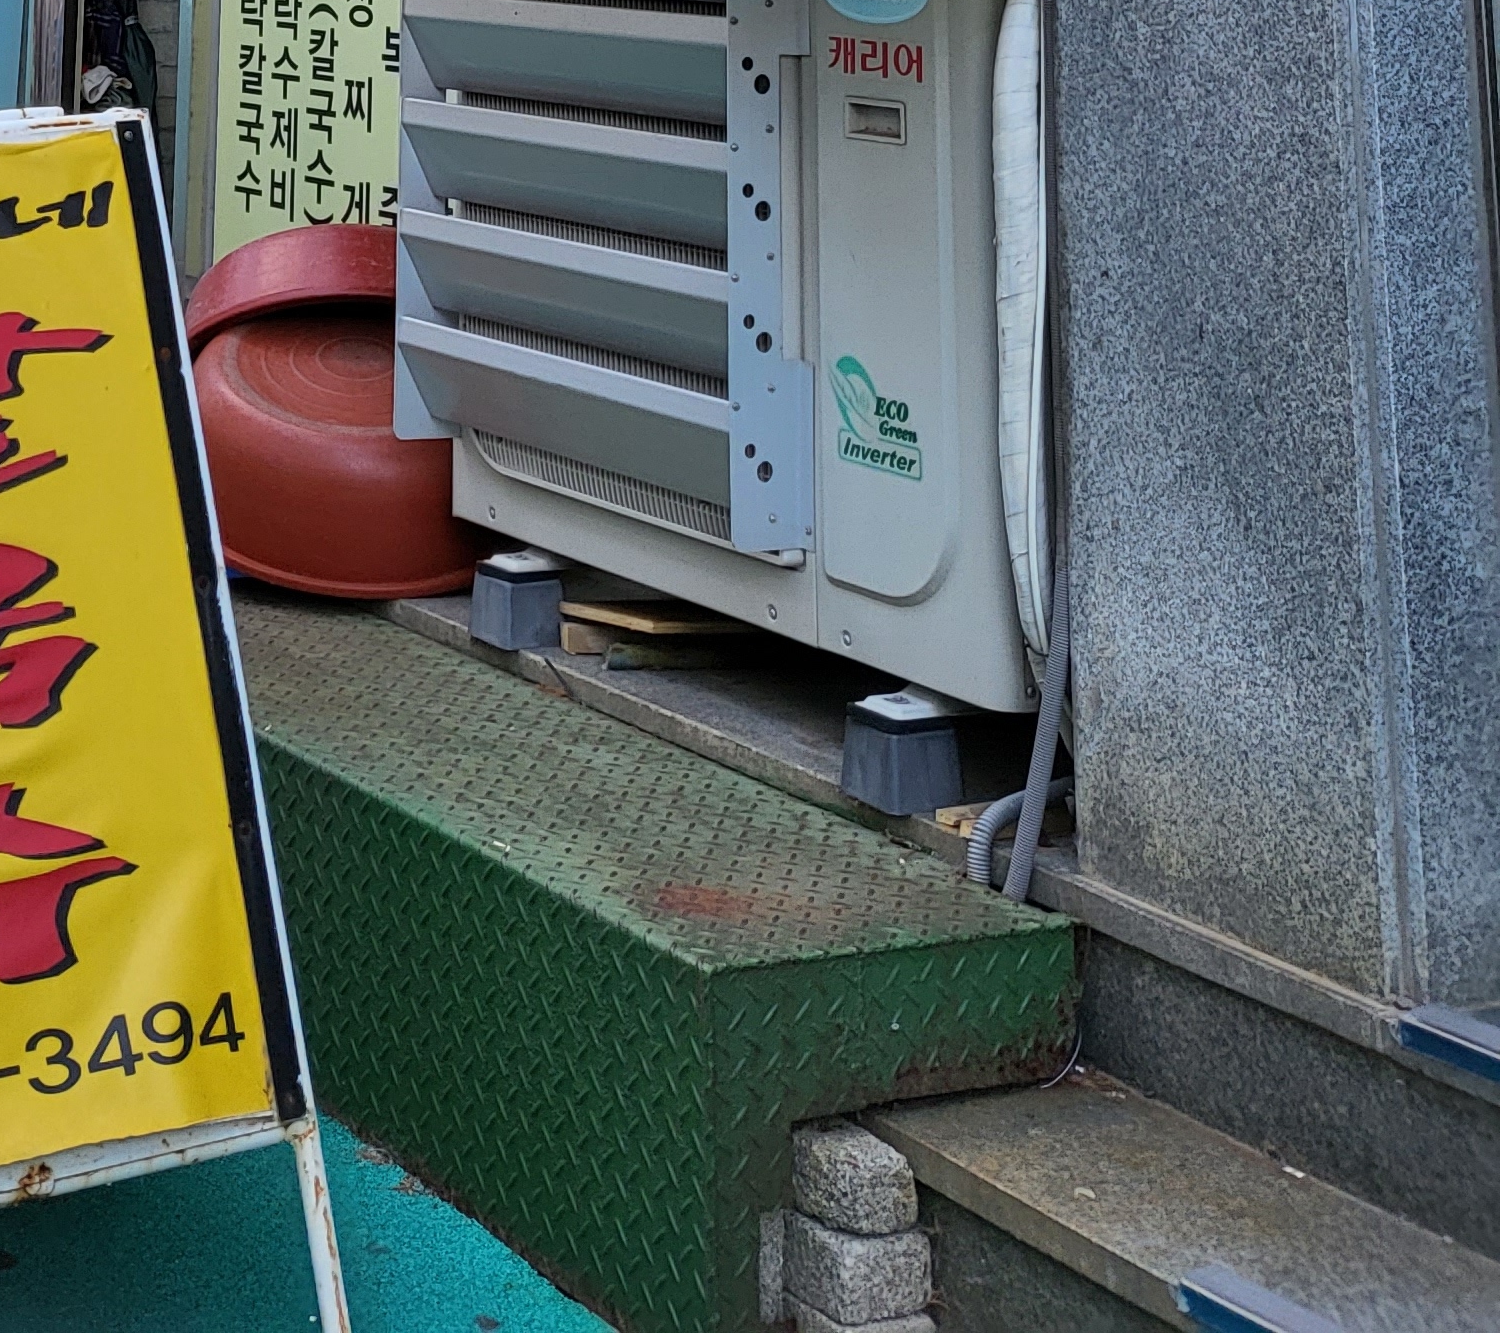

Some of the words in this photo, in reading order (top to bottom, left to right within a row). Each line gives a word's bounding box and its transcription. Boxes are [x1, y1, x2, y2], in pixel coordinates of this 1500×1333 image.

[828, 36, 923, 84] 캐리어
[874, 395, 909, 423] ECO
[879, 419, 918, 444] Green
[843, 436, 917, 473] Inverter
